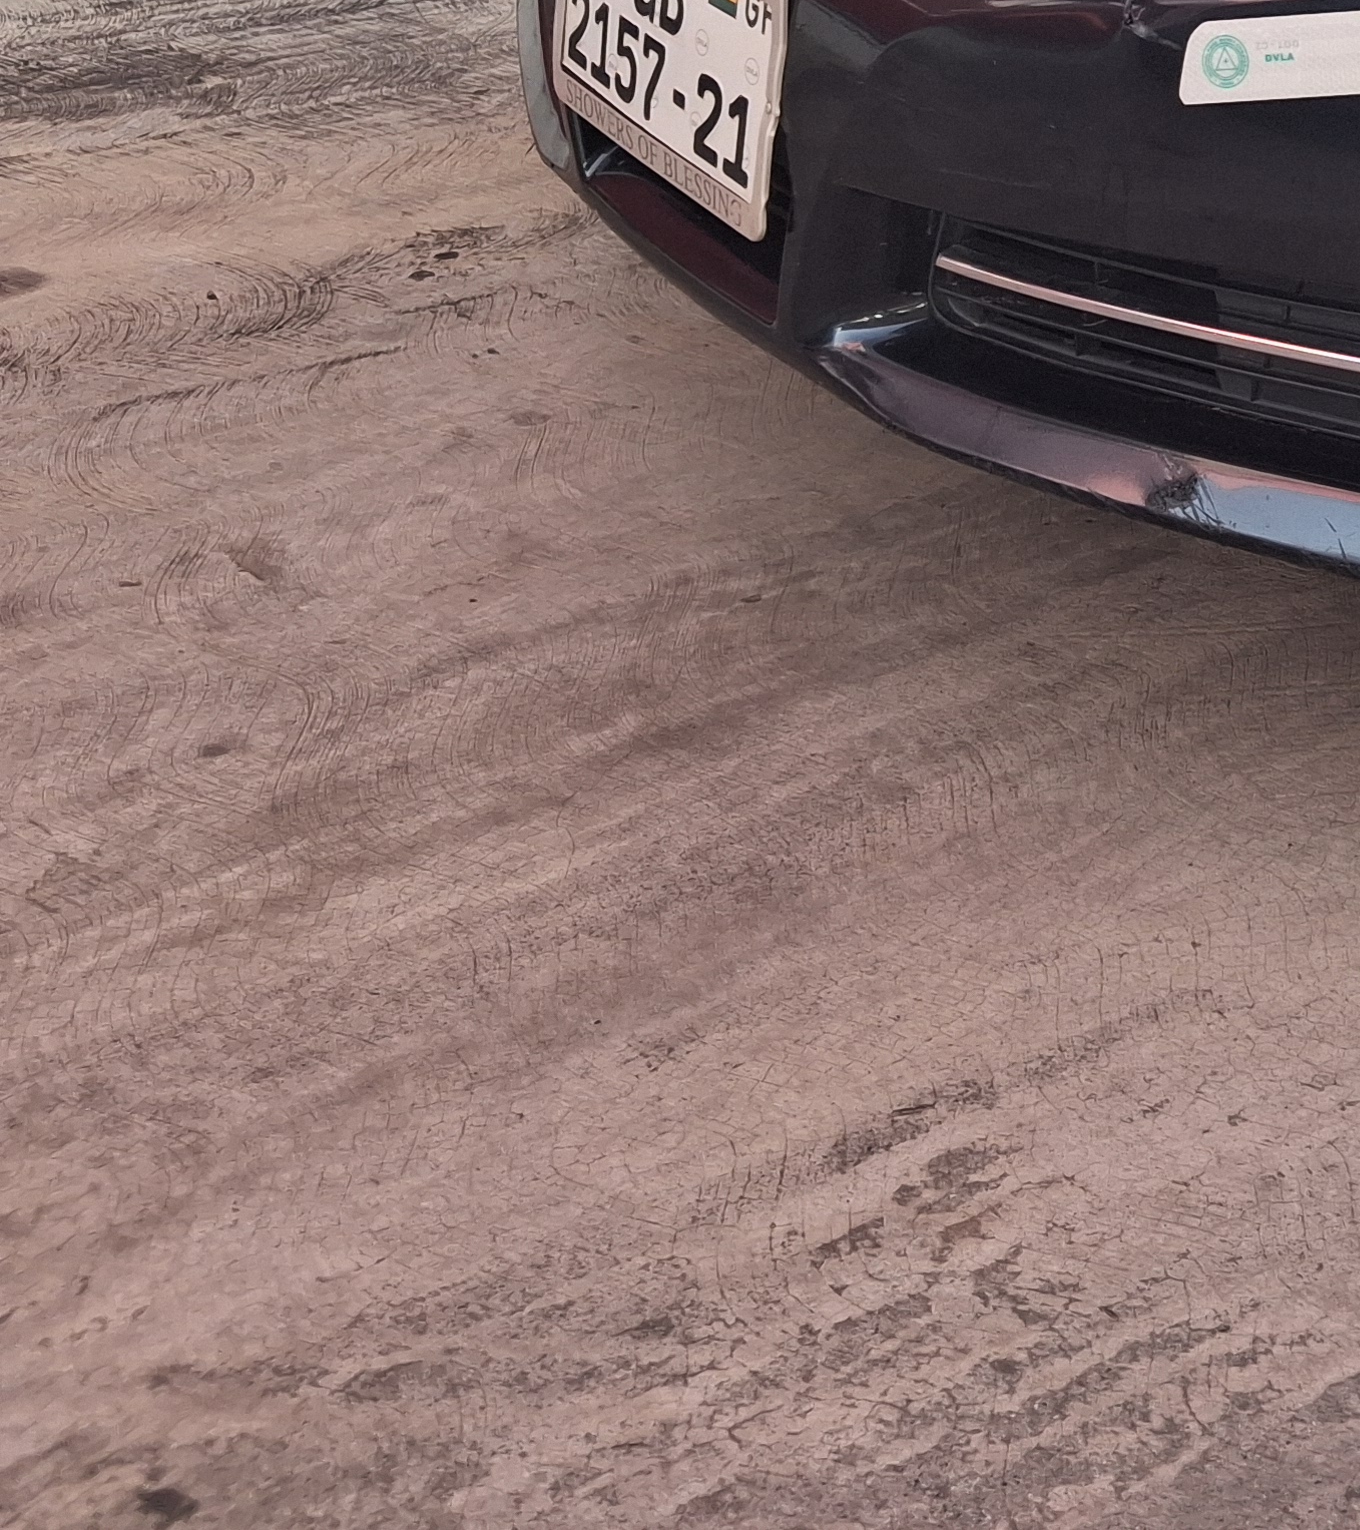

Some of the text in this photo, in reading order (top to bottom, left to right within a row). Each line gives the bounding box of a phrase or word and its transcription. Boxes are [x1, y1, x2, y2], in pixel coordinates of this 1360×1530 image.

[1265, 52, 1295, 62] DVLA
[566, 78, 743, 227] SHOWERS OF BLESSING
